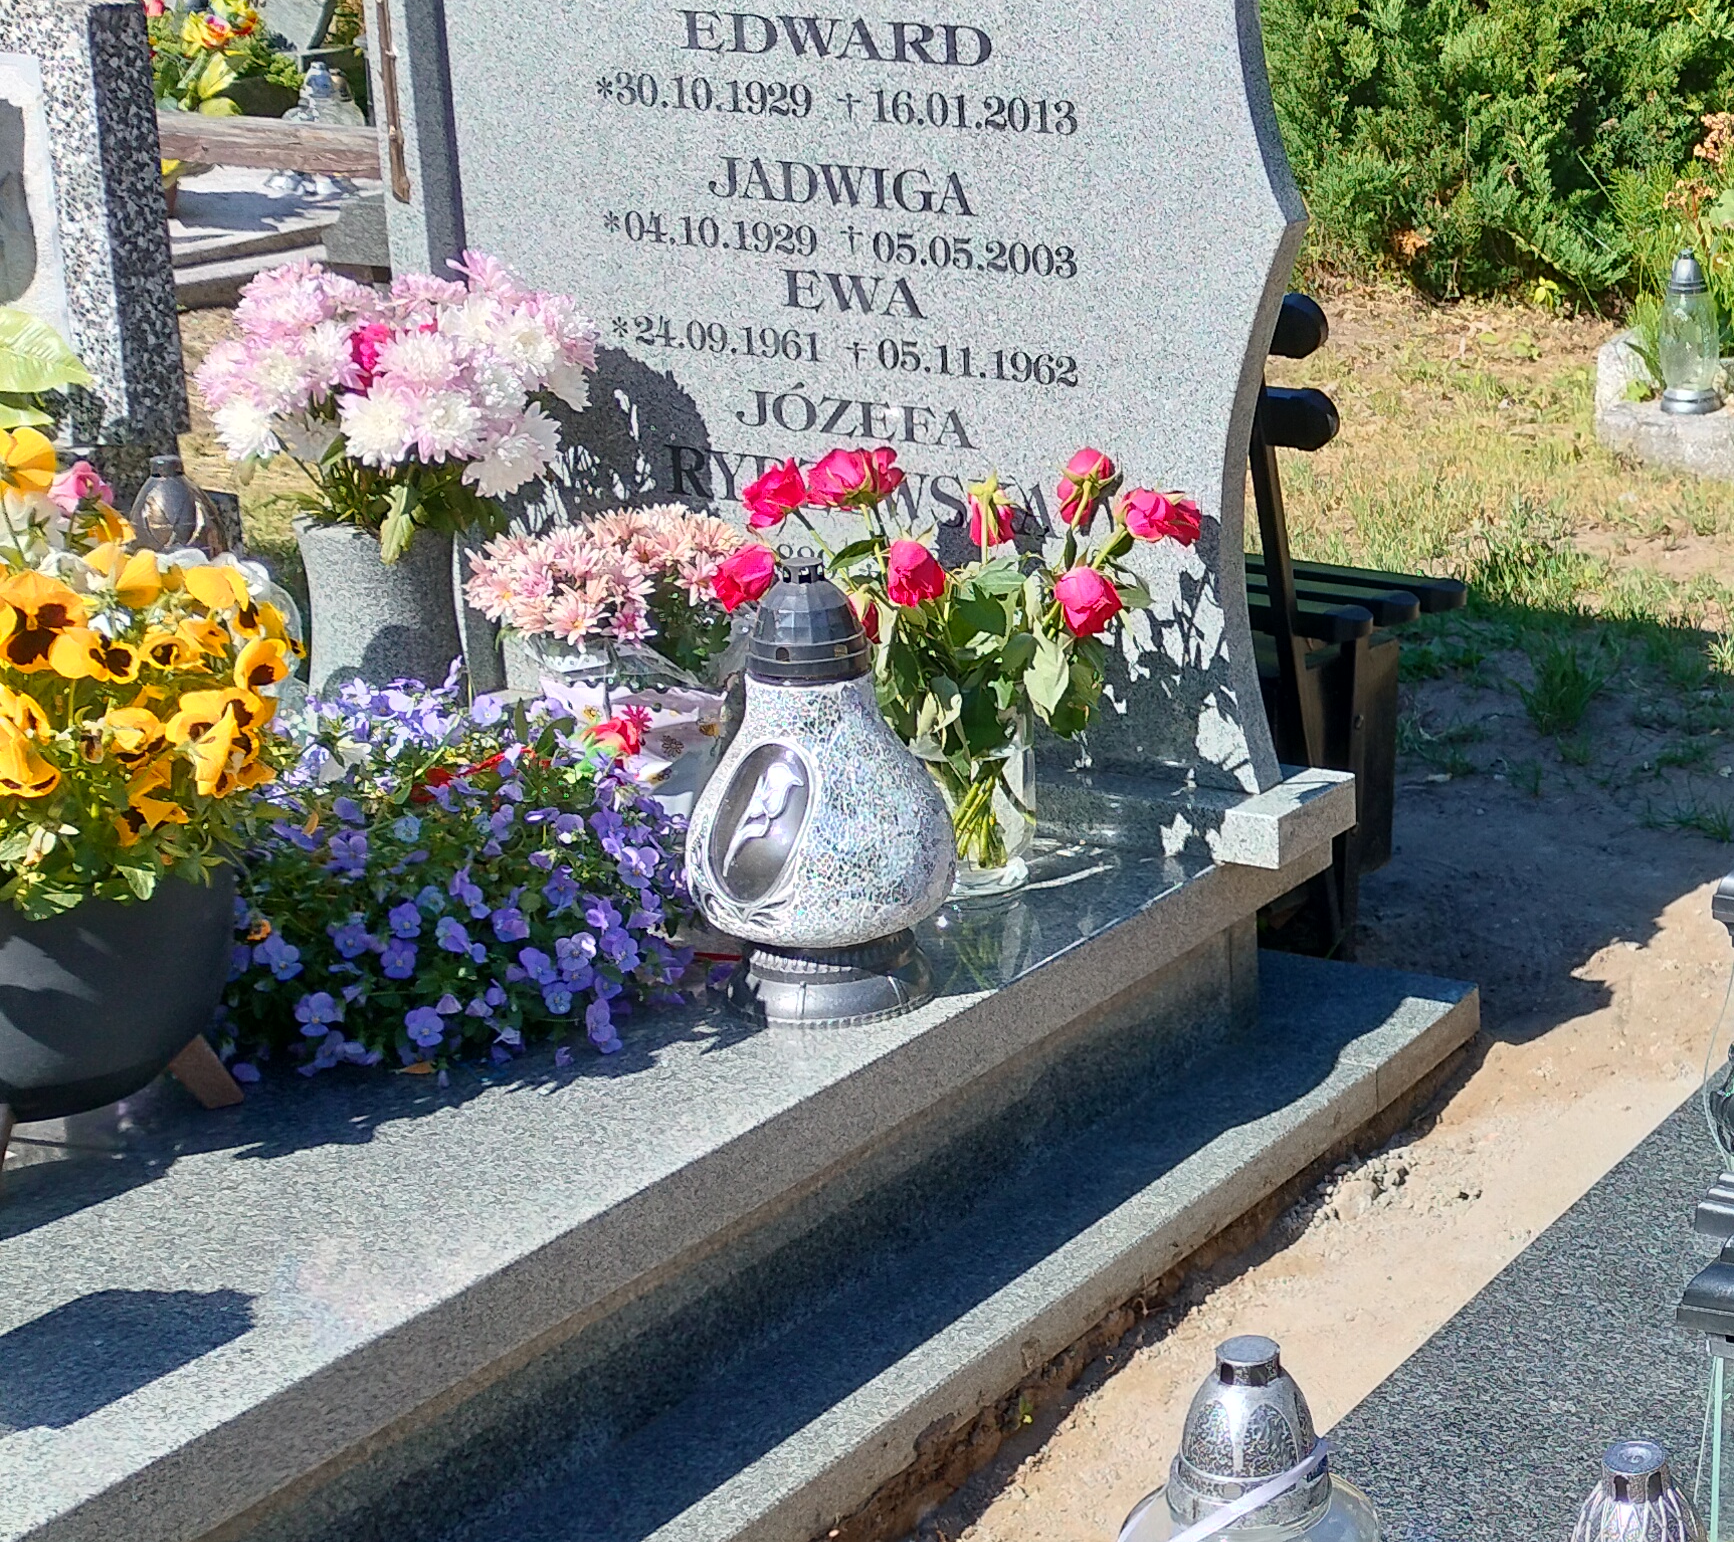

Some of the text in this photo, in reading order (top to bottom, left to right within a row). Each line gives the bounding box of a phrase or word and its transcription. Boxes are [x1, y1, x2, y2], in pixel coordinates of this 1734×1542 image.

[676, 8, 993, 68] EDWARD
[708, 156, 979, 218] JADWIGA
[781, 268, 929, 320] EWA
[737, 382, 979, 449] JÓZEFA
